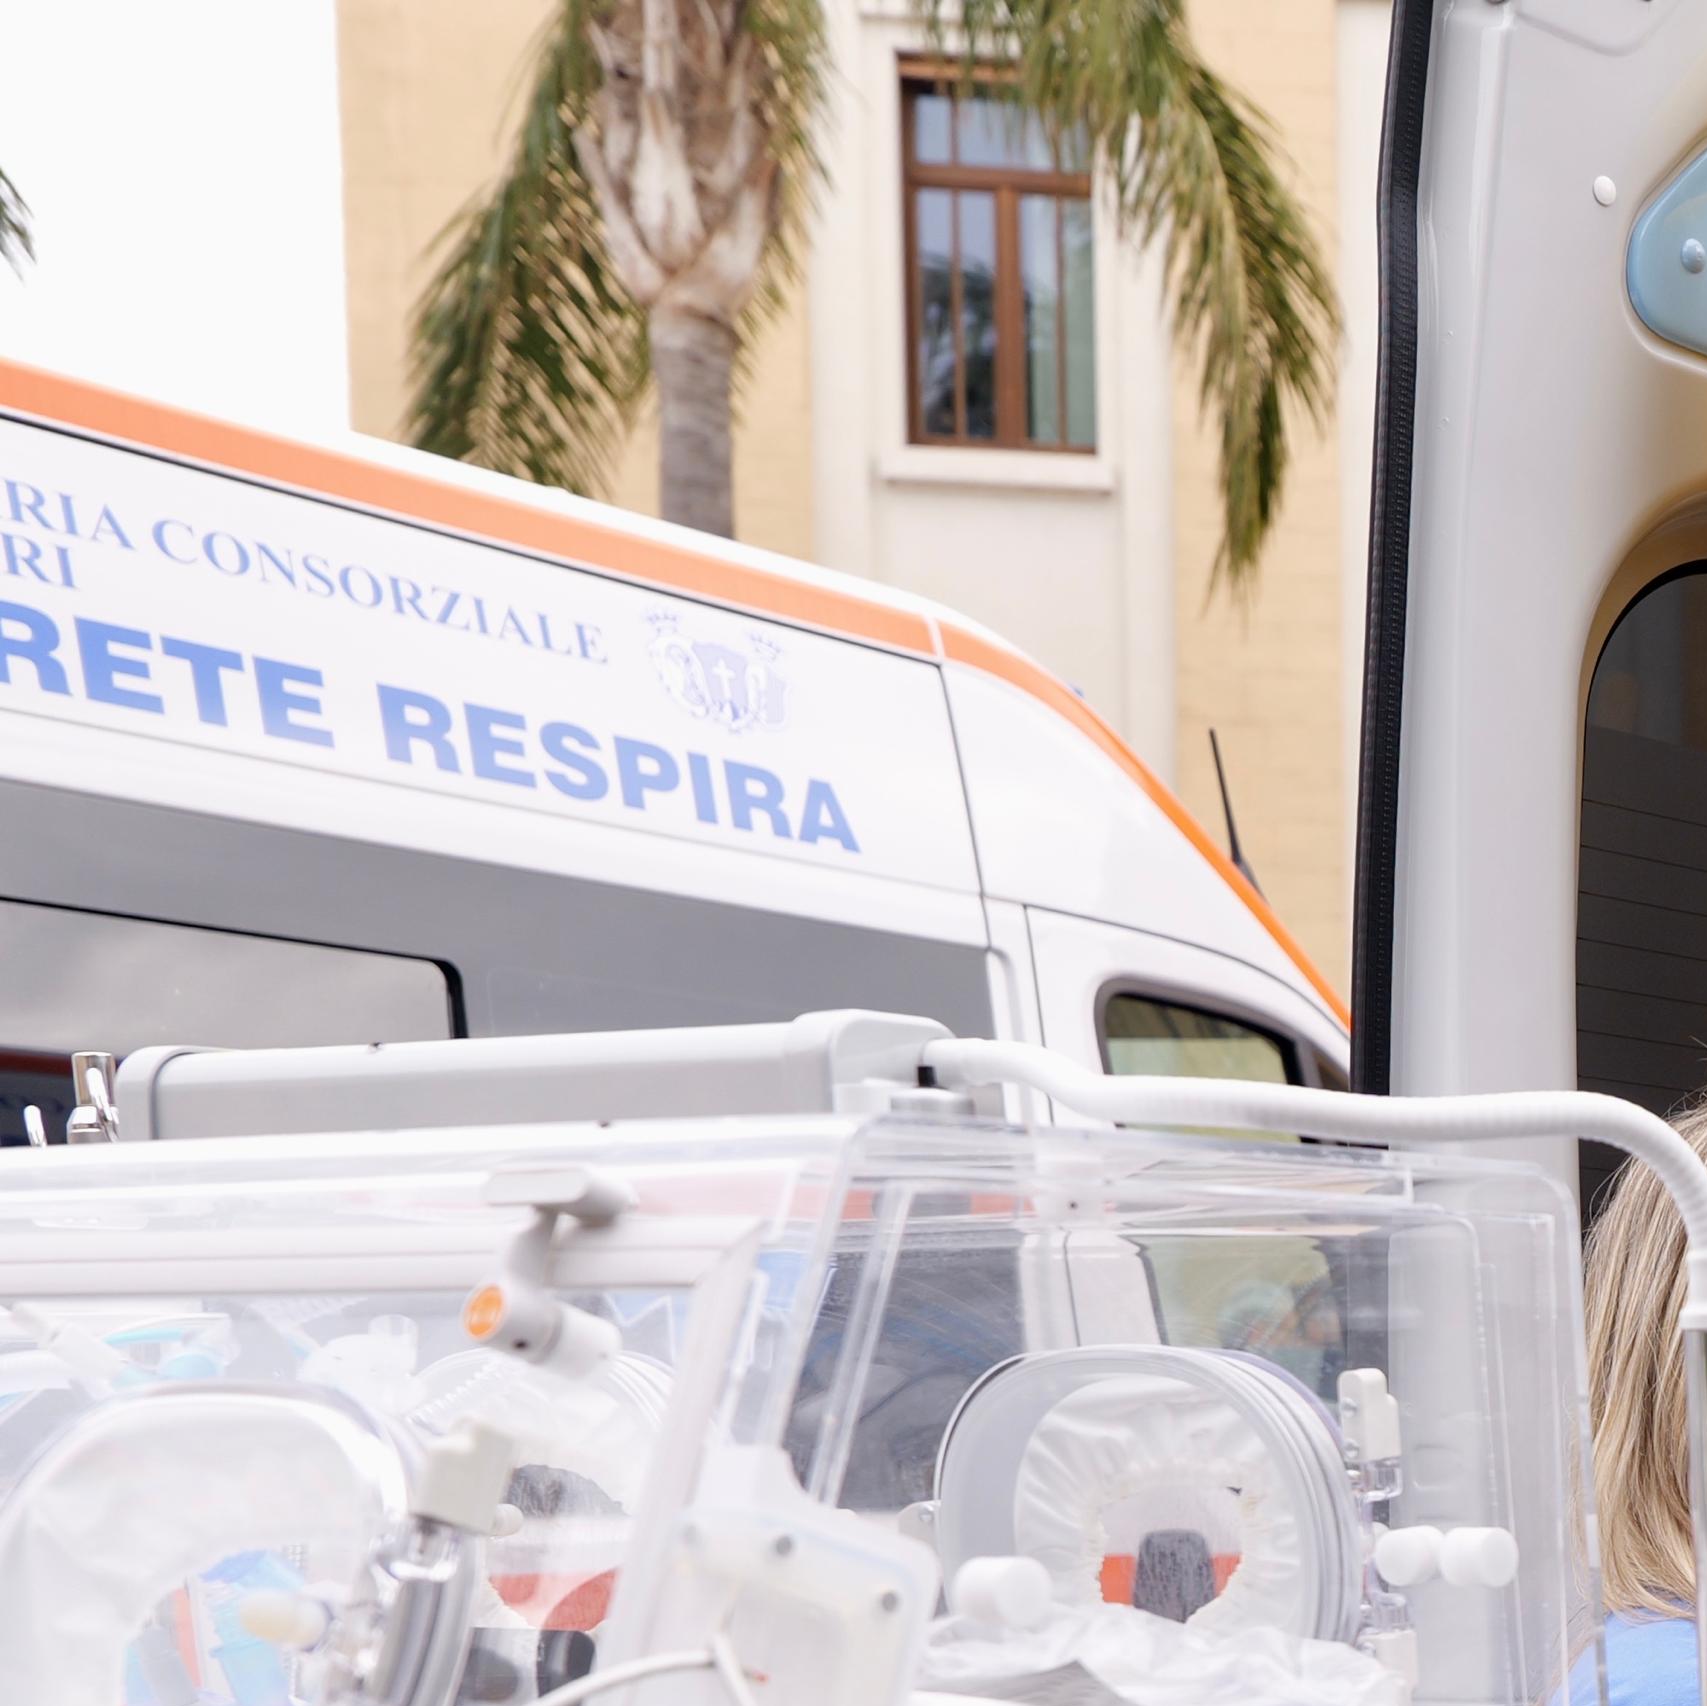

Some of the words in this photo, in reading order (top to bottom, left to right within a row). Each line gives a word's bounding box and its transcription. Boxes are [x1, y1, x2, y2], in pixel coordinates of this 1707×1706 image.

[152, 518, 608, 665] CONSORZIALE
[0, 599, 334, 749] RETE
[376, 682, 862, 855] RESPIRA
